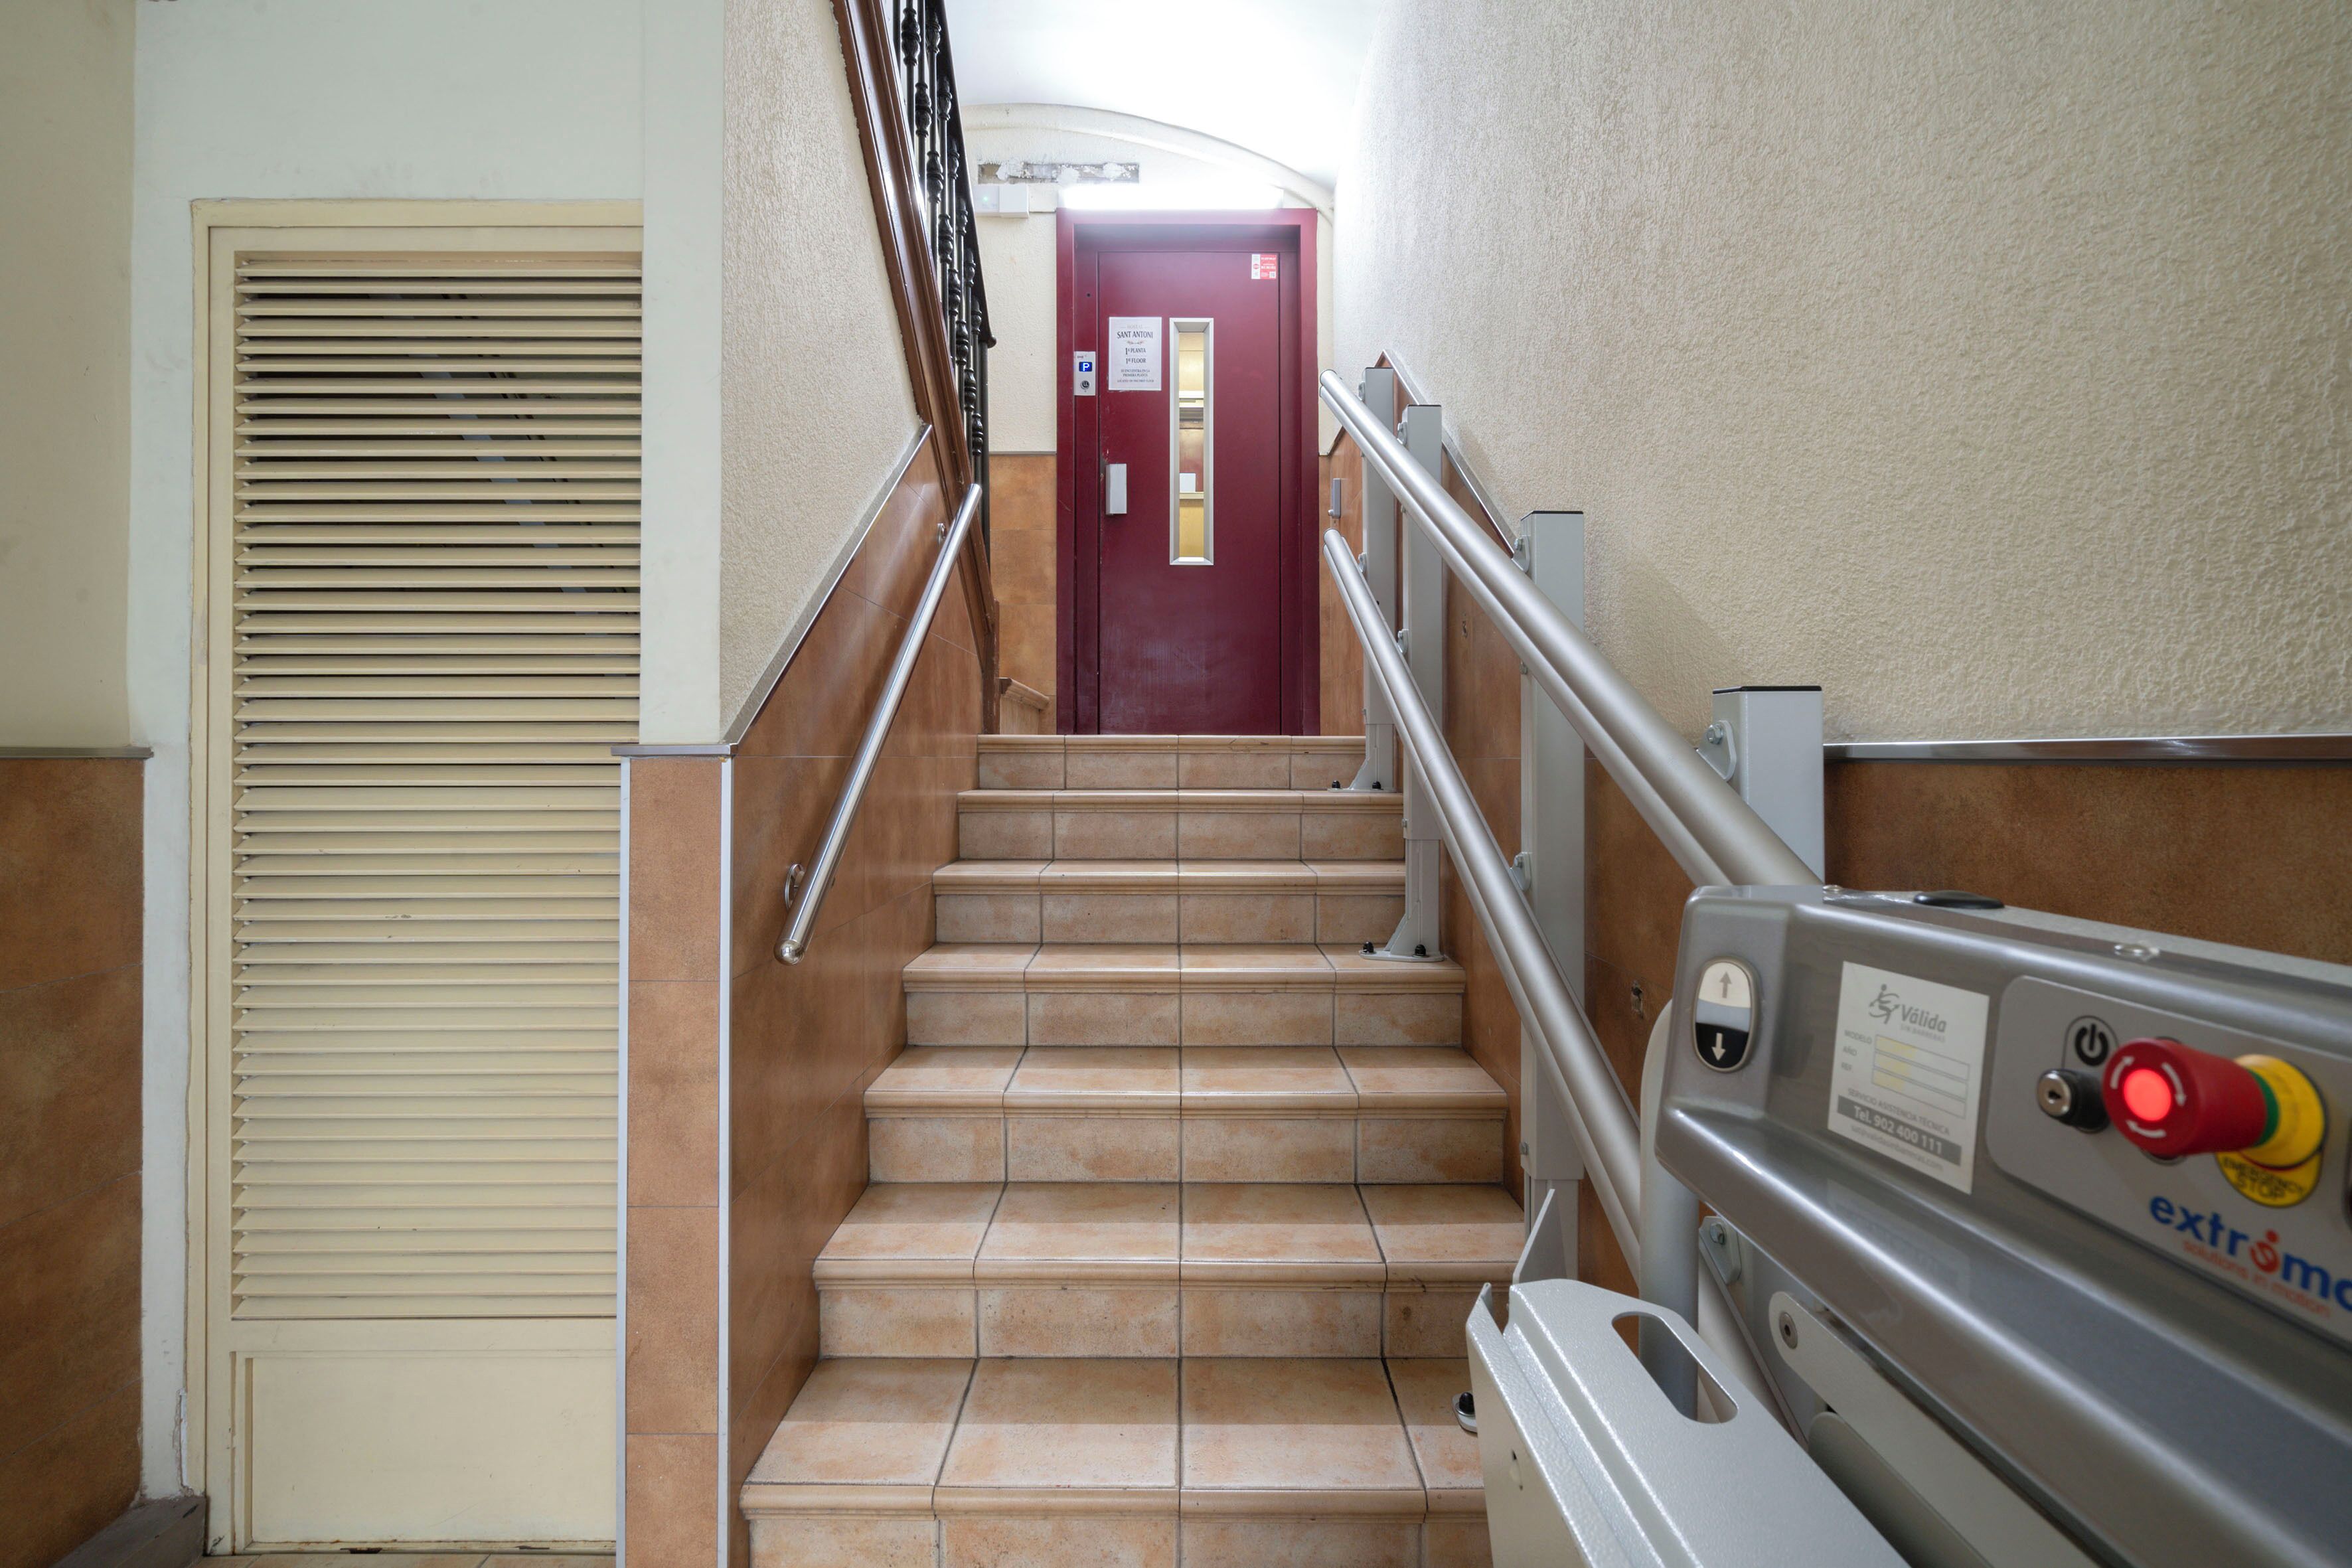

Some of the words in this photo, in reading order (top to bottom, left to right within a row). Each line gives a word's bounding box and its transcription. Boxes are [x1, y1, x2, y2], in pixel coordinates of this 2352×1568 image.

[1117, 331, 1131, 339] SANT
[1083, 362, 1090, 372] P
[1901, 1004, 1947, 1032] Válida
[1844, 1030, 1873, 1045] MODELO
[1853, 1105, 1873, 1125] Tel.
[1874, 1117, 1895, 1134] 902
[1897, 1128, 1919, 1143] 400
[1921, 1135, 1942, 1155] 111
[2235, 1176, 2286, 1198] STOP
